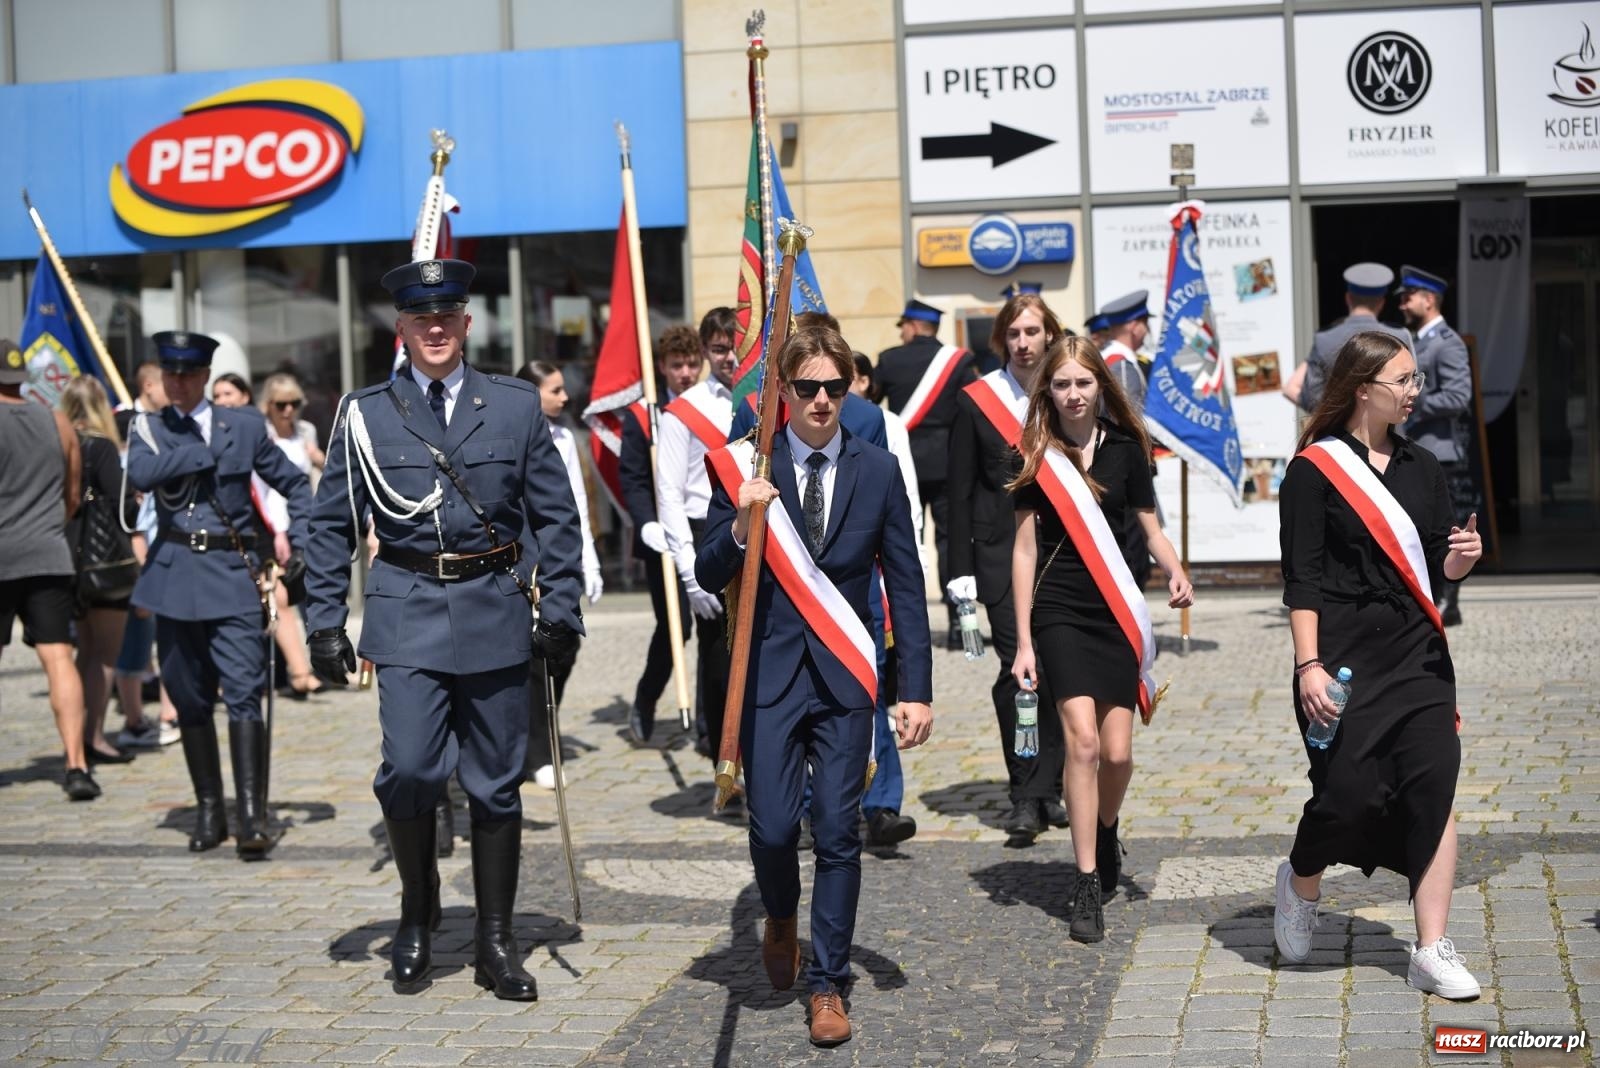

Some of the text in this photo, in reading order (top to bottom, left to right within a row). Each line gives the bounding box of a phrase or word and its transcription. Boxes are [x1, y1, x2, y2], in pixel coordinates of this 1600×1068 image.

[924, 63, 1056, 98] I PIĘTRO
[1104, 87, 1270, 107] MOSTOSTAL ZABRZE
[1348, 124, 1433, 143] FRYZJER
[1545, 116, 1600, 138] KOFEI
[1559, 139, 1600, 152] KAWIA
[148, 128, 323, 185] PEPCO
[1208, 235, 1262, 250] POLECA
[1469, 232, 1522, 260] LODY
